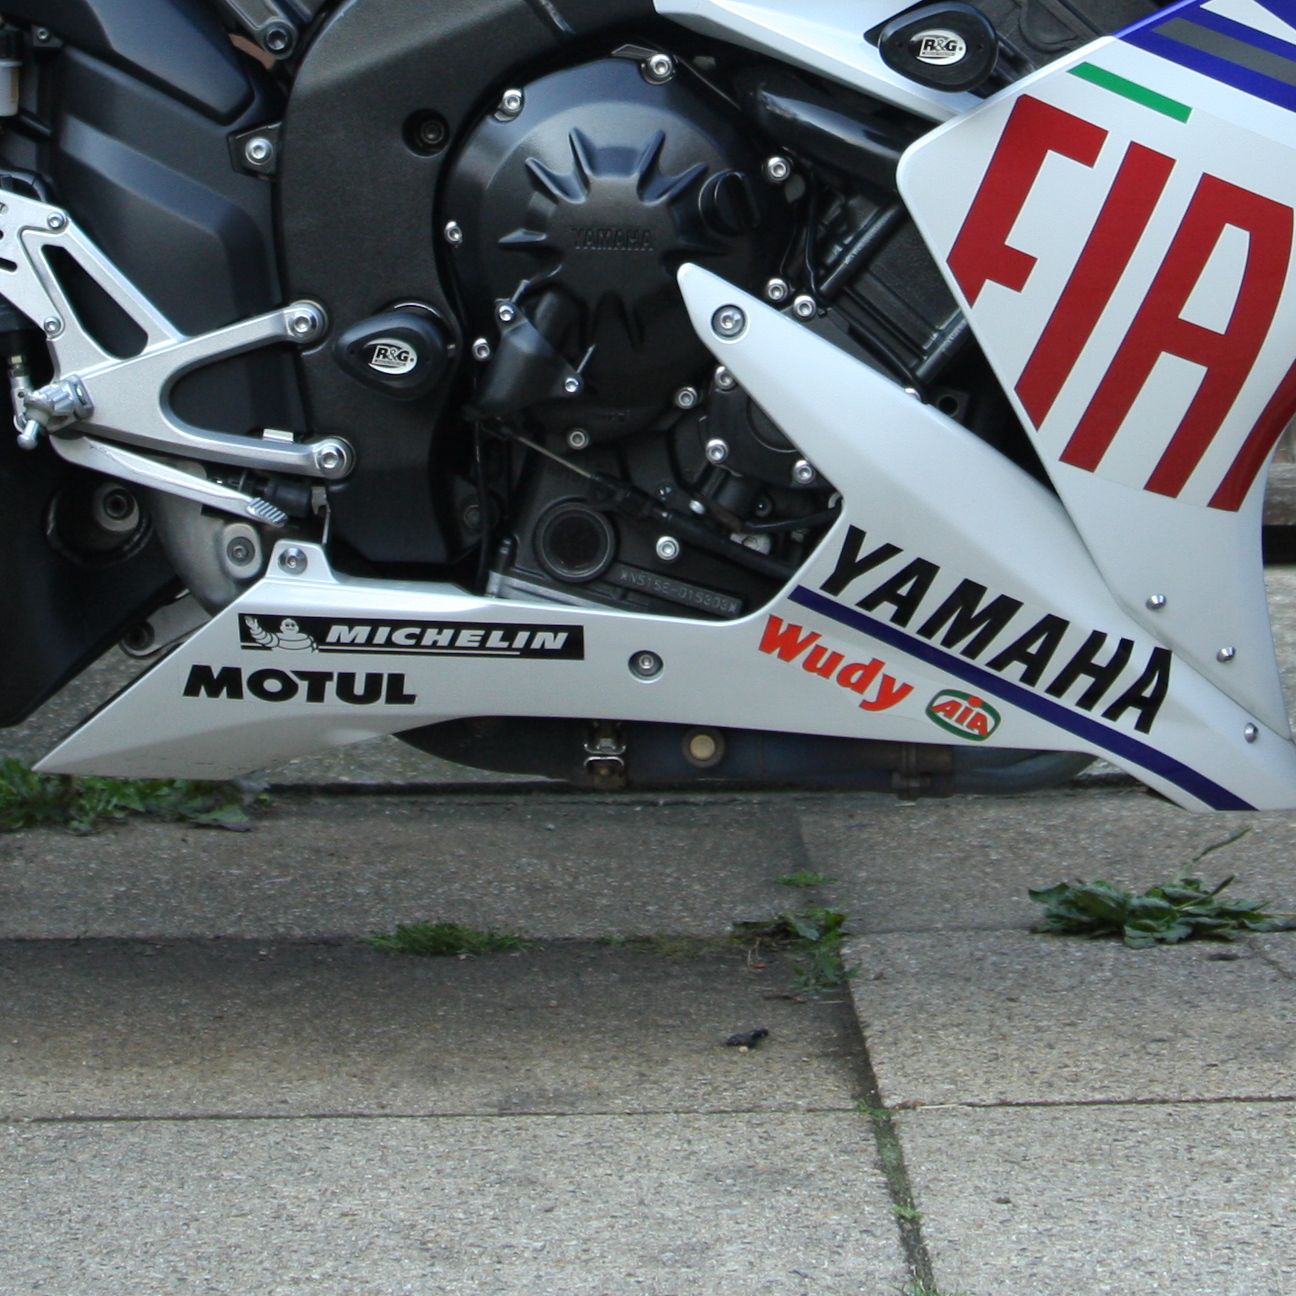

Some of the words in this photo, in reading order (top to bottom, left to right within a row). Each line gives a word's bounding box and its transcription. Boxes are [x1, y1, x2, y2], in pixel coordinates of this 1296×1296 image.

[922, 38, 959, 53] R&G
[571, 227, 657, 251] YAMAHA
[376, 347, 410, 362] R&G
[325, 625, 569, 651] MICHELIN
[819, 524, 1173, 735] YAMAHA
[757, 614, 914, 712] Wudy
[182, 663, 417, 705] MOTUL
